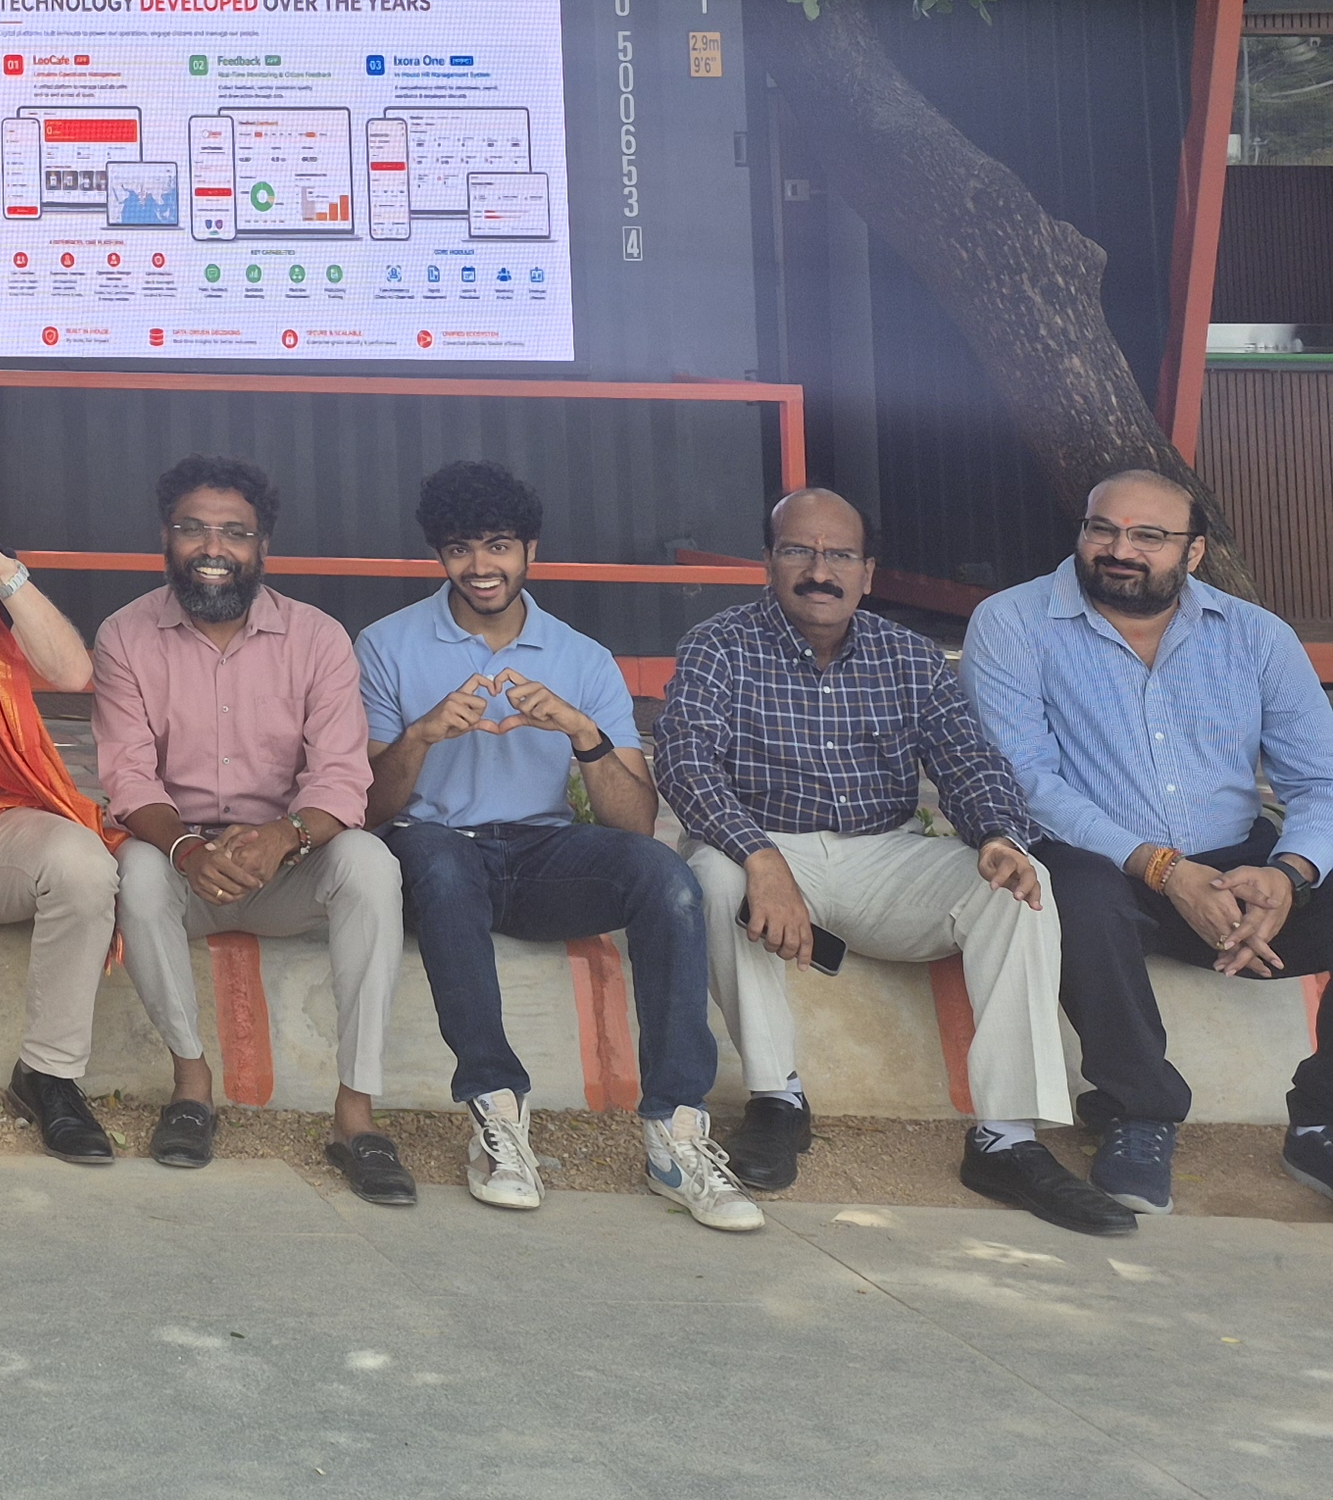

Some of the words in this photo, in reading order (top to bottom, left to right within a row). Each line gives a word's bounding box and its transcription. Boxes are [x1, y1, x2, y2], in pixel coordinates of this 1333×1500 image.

[691, 35, 720, 53] 2,9m
[7, 60, 19, 70] 01
[33, 55, 70, 66] LooCafe
[193, 60, 204, 70] 02
[217, 55, 261, 66] Feedback
[369, 60, 382, 70] 03
[393, 55, 420, 66] Ixora
[423, 55, 445, 66] One
[617, 31, 639, 217] 500653
